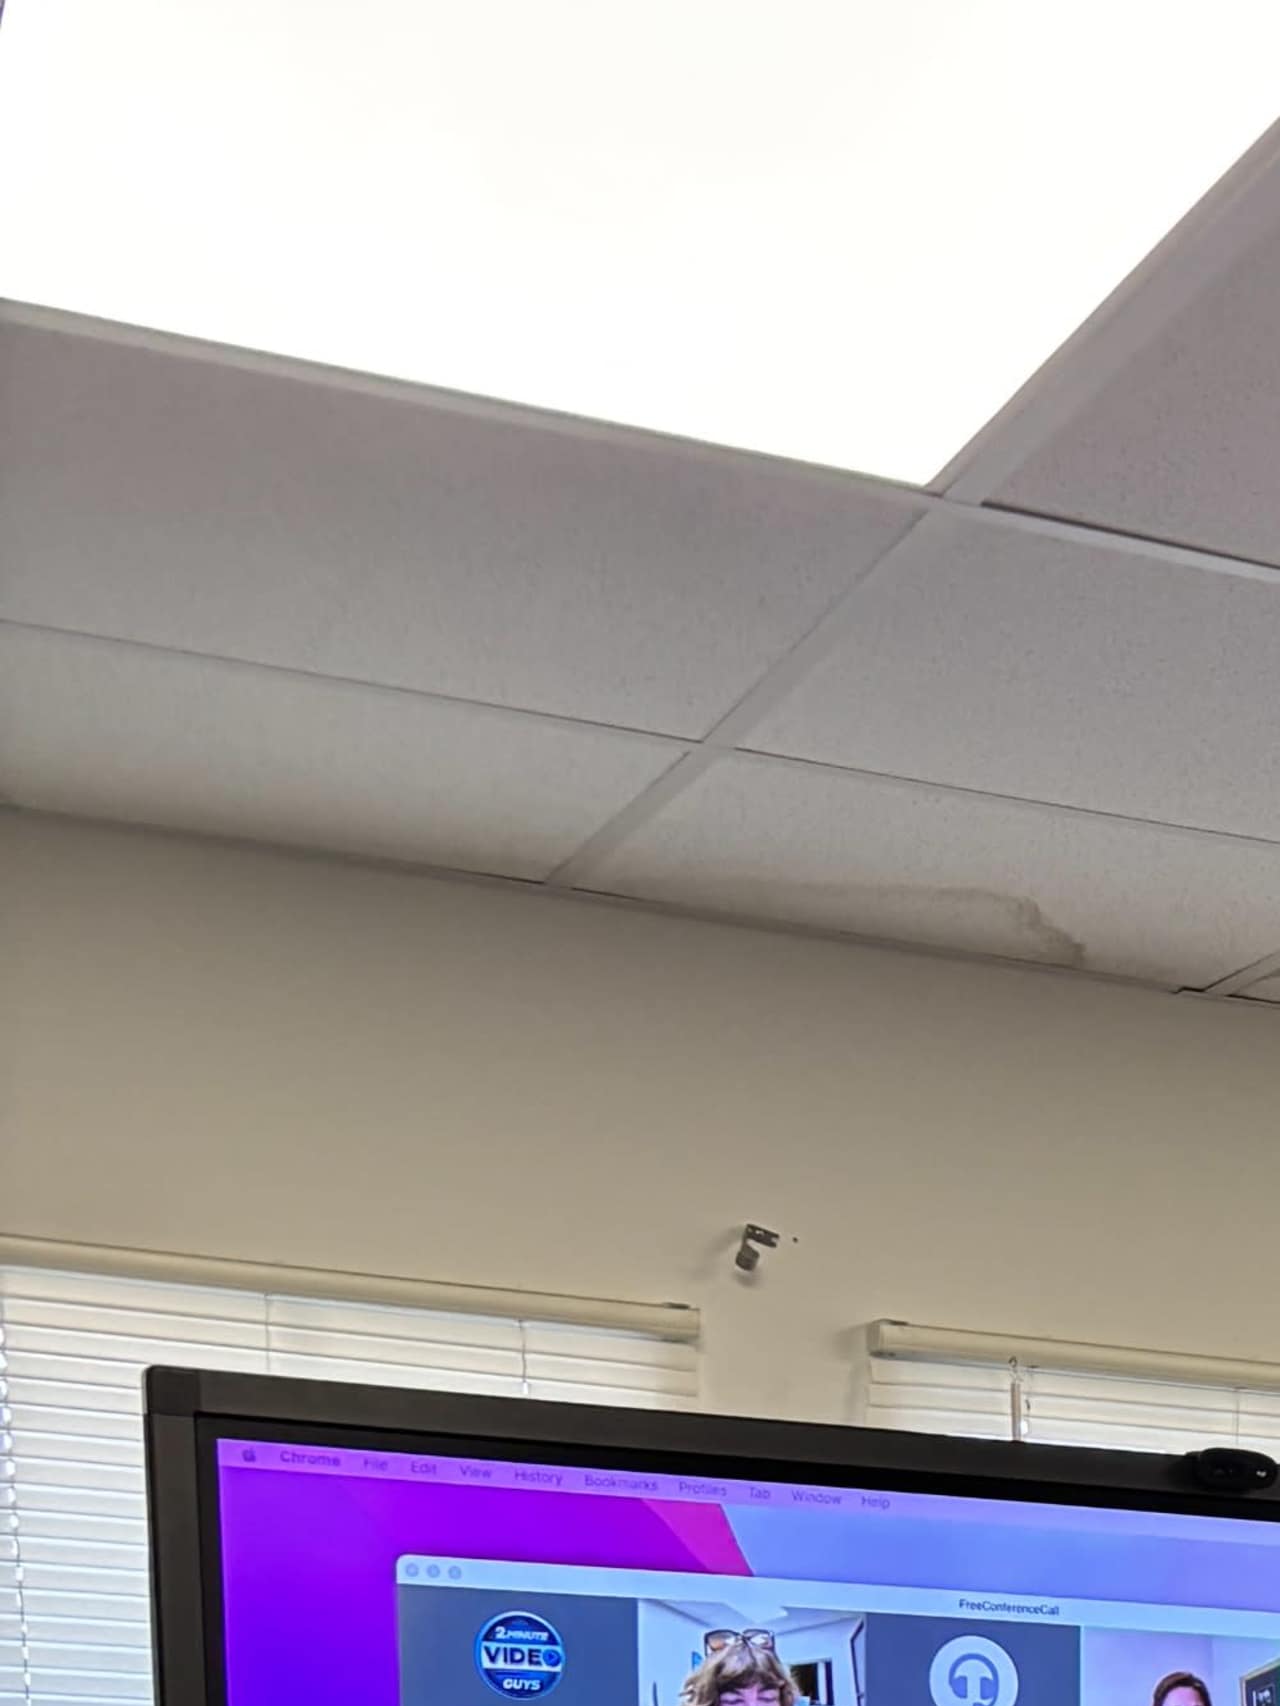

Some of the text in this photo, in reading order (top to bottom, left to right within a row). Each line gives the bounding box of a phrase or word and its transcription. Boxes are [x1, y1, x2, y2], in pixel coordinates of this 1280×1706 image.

[279, 1451, 890, 1510] Chrome File Edit View History Bookmarks Profiles Tab Window Help
[959, 1599, 1060, 1616] FreeConferenceCall
[503, 1679, 541, 1690] GUYS
